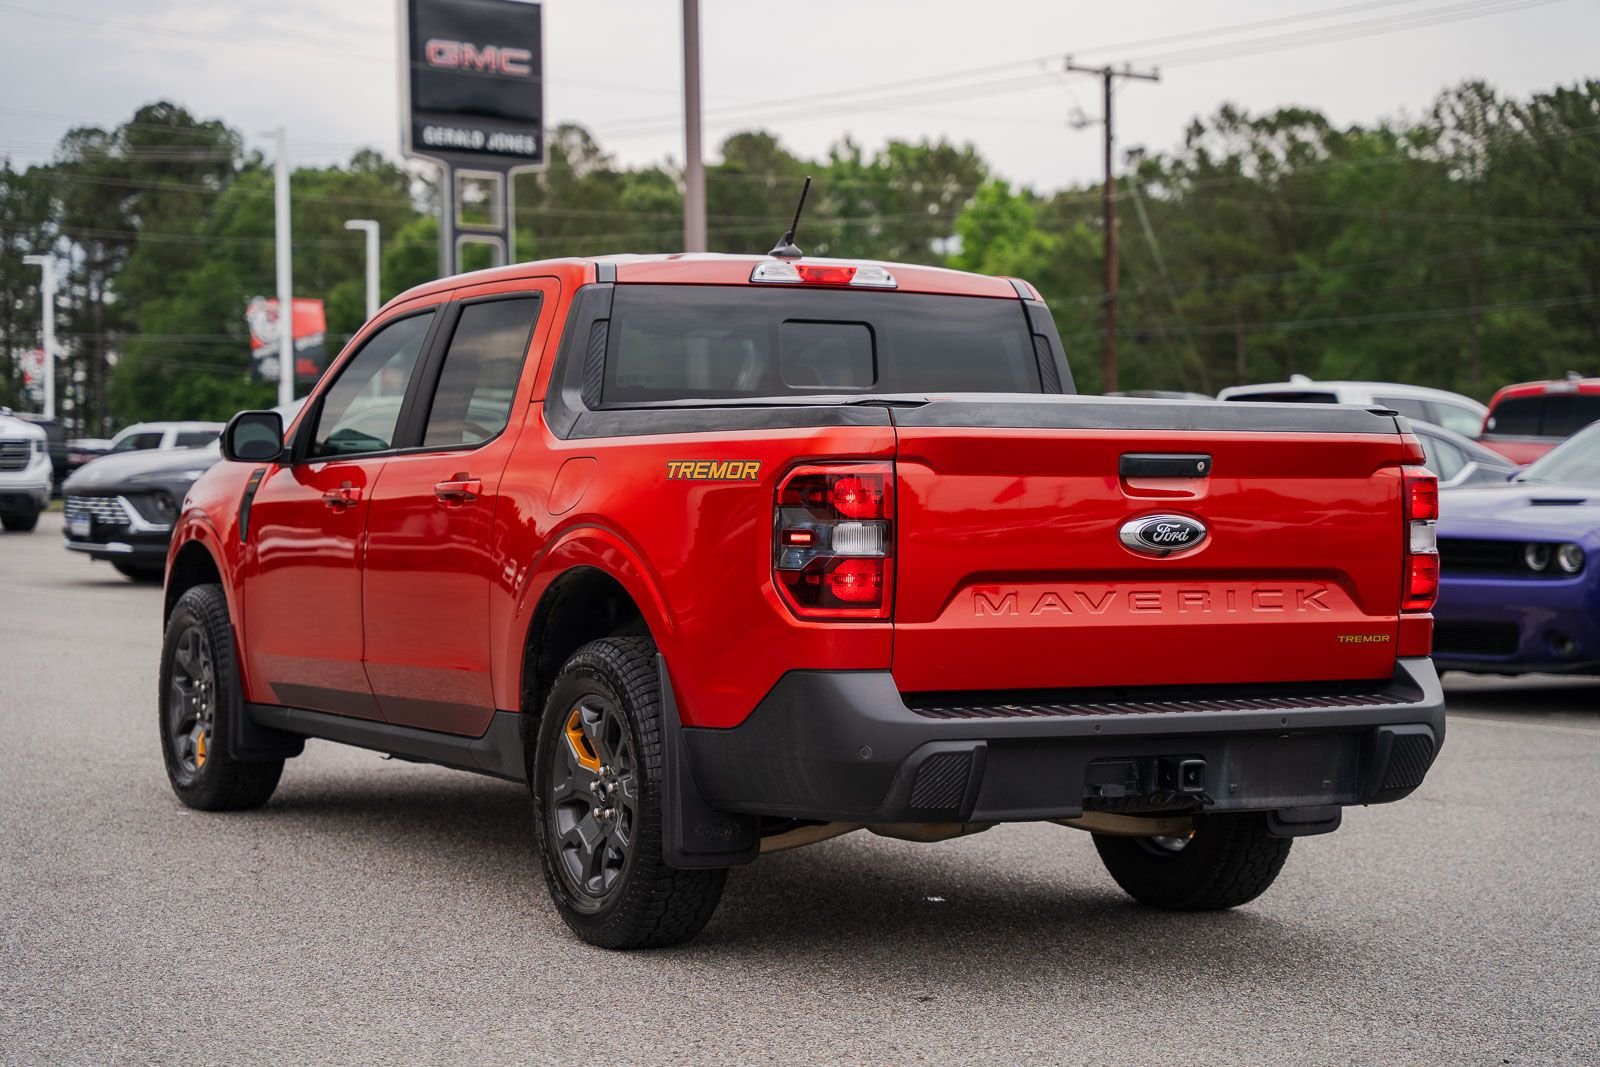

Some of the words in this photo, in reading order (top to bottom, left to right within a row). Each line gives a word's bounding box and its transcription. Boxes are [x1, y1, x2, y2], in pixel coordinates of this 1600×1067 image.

[425, 39, 533, 75] GMC
[423, 125, 485, 149] GERALD
[486, 132, 537, 155] JONES
[666, 460, 762, 480] TREMOR
[1153, 523, 1190, 542] Ford
[972, 588, 1332, 617] MAVERICK
[1336, 634, 1391, 643] TREMOR
